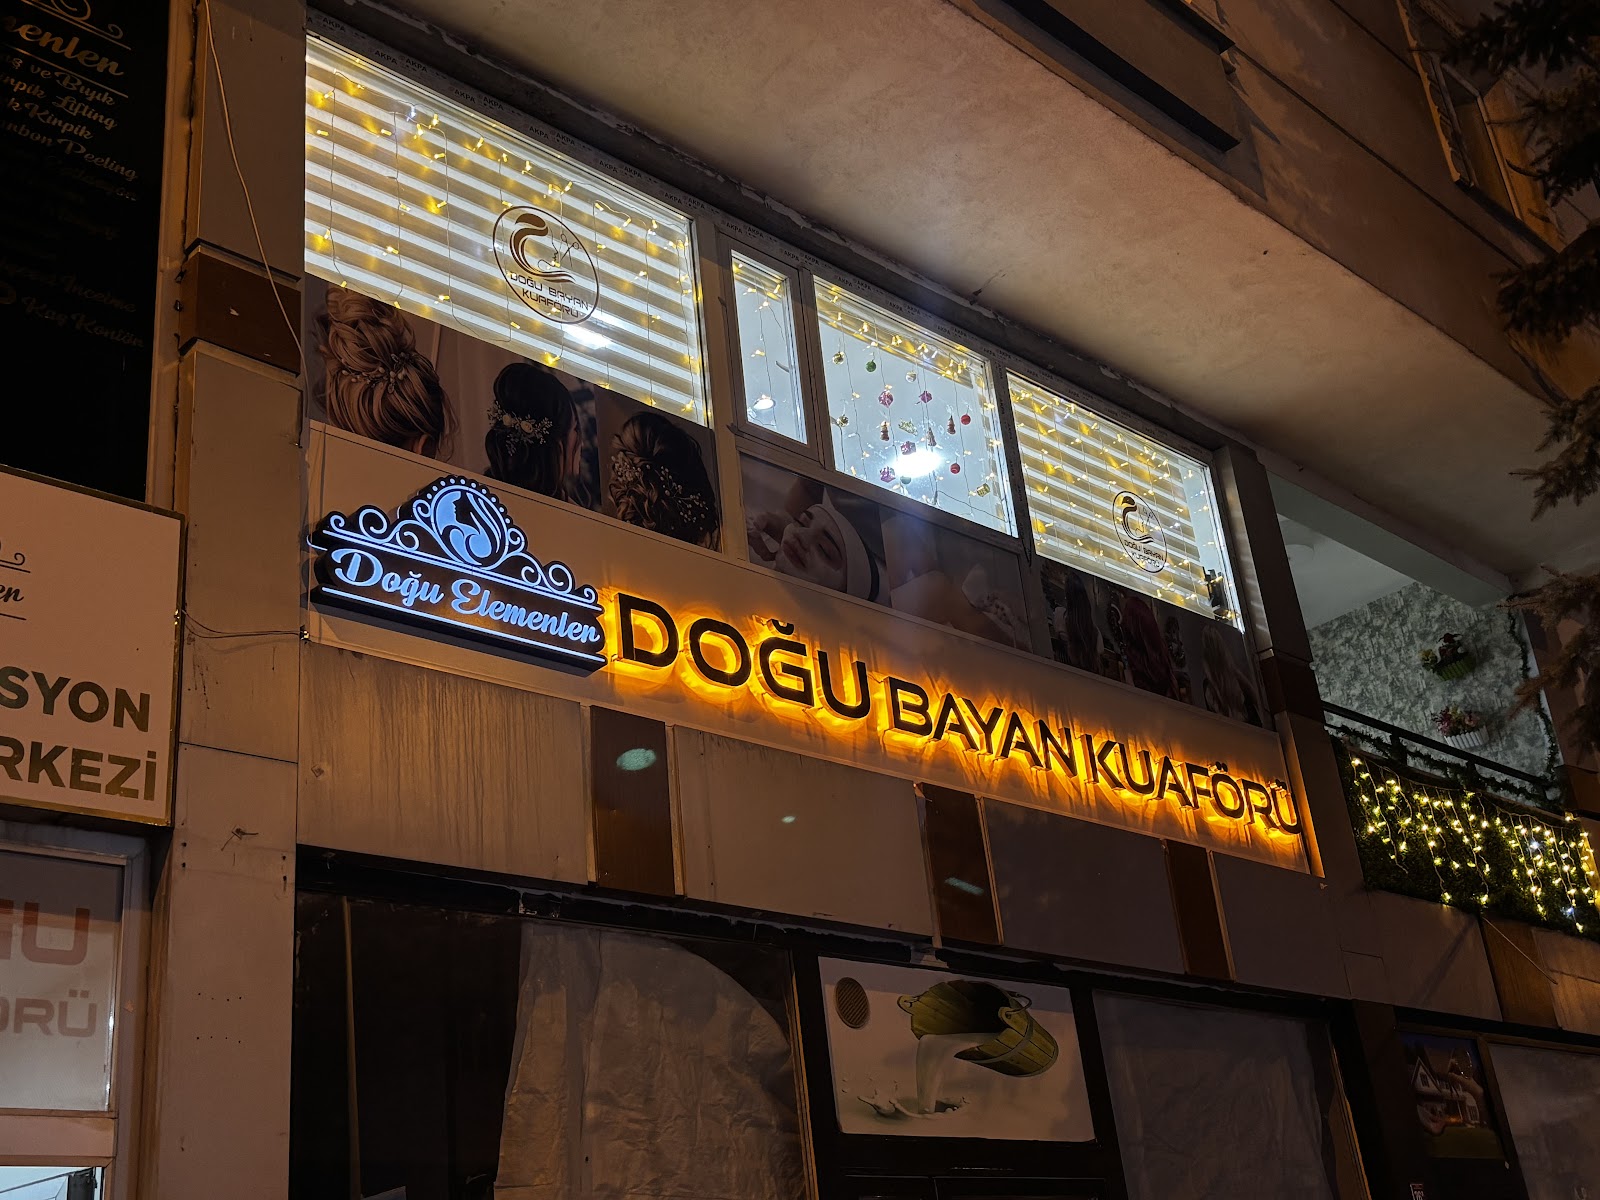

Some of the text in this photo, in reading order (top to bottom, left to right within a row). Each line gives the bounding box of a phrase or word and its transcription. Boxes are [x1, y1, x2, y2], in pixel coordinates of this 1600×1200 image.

[57, 138, 139, 181] Peeling
[323, 18, 345, 32] AKPA
[406, 58, 428, 72] AKPA
[483, 96, 504, 110] AKPA
[556, 132, 576, 146] AKPA
[624, 166, 642, 178] AKPA
[688, 198, 705, 209] AKPA
[748, 226, 764, 238] AKPA
[375, 50, 398, 65] AKPA
[454, 88, 476, 104] AKPA
[529, 126, 549, 140] AKPA
[600, 160, 618, 173] AKPA
[664, 192, 683, 204] AKPA
[726, 222, 742, 234] AKPA
[548, 286, 589, 311] BAYAN
[331, 548, 445, 607] Doğu
[0, 666, 150, 733] SYON
[614, 592, 1300, 835] DOĞU BAYAN KUAFÖRÜ
